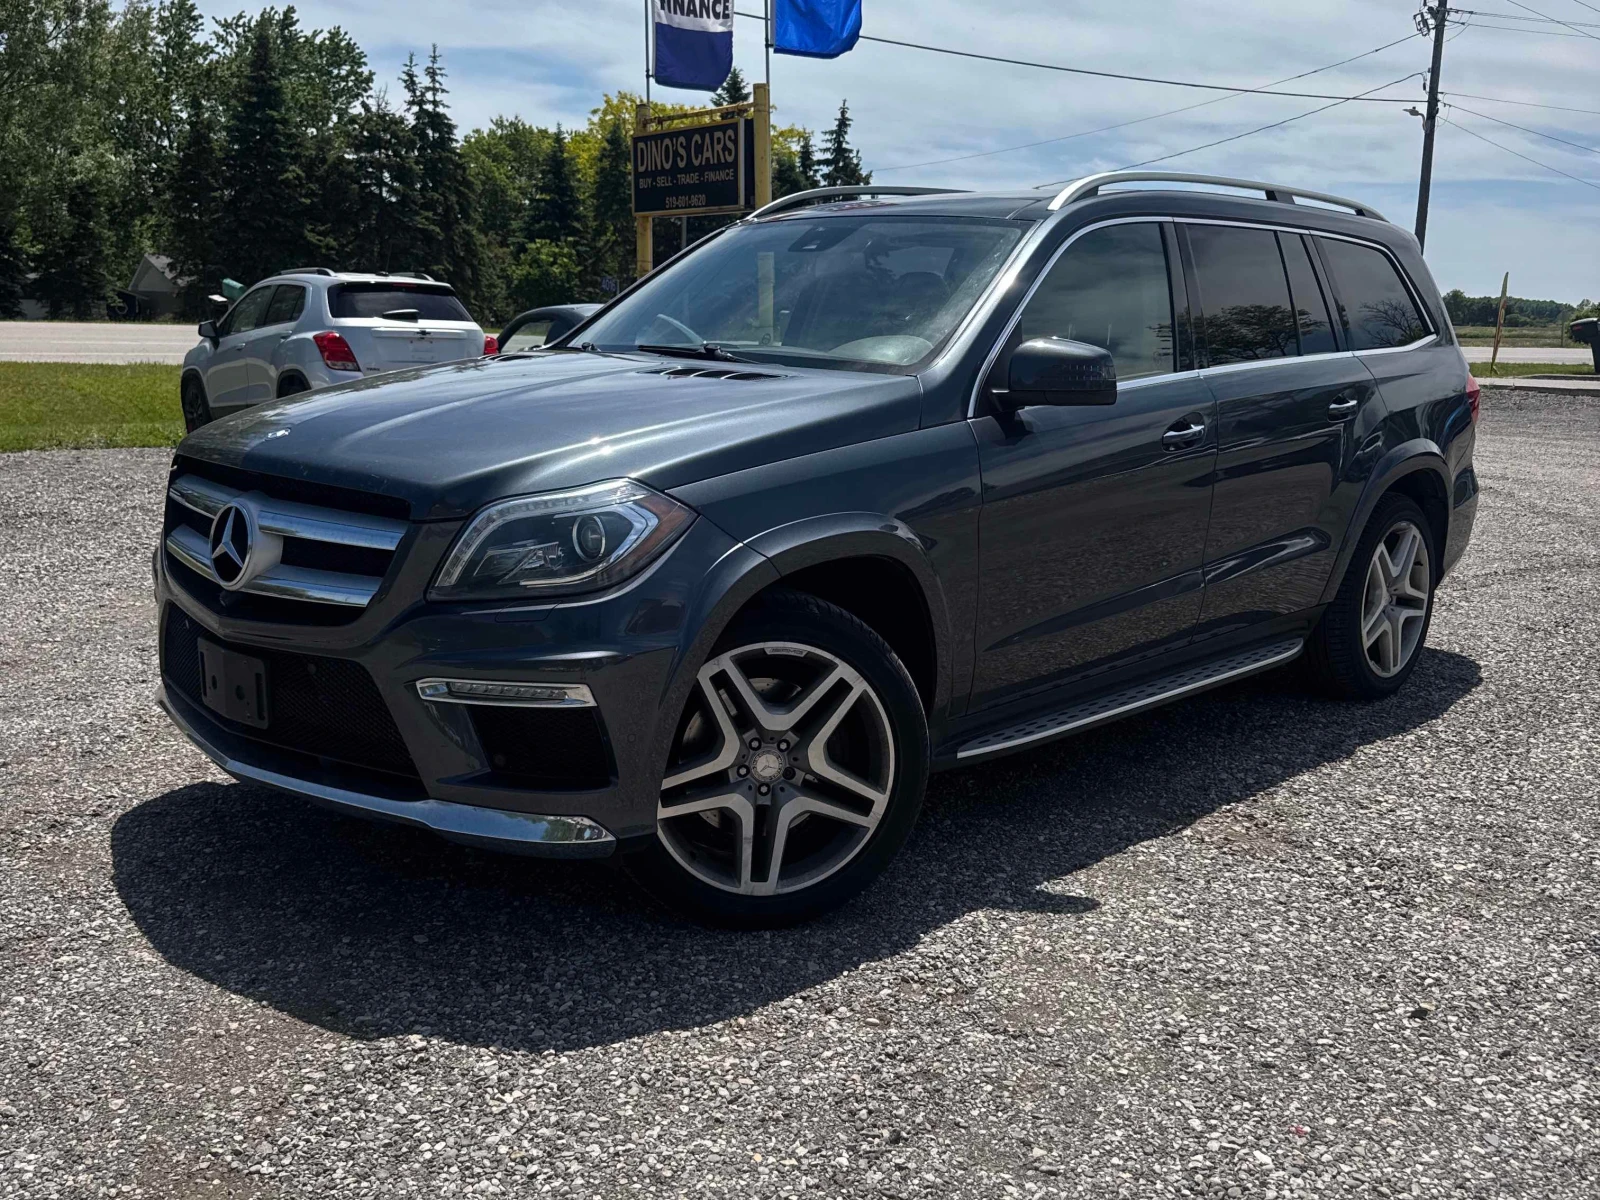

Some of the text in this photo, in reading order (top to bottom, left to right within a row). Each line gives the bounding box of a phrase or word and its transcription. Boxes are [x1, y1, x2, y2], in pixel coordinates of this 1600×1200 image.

[637, 129, 735, 173] DINO'S CARS
[639, 178, 652, 189] BUY
[656, 176, 672, 187] SELL
[677, 172, 700, 184] TRADE
[704, 169, 734, 183] FINANCE
